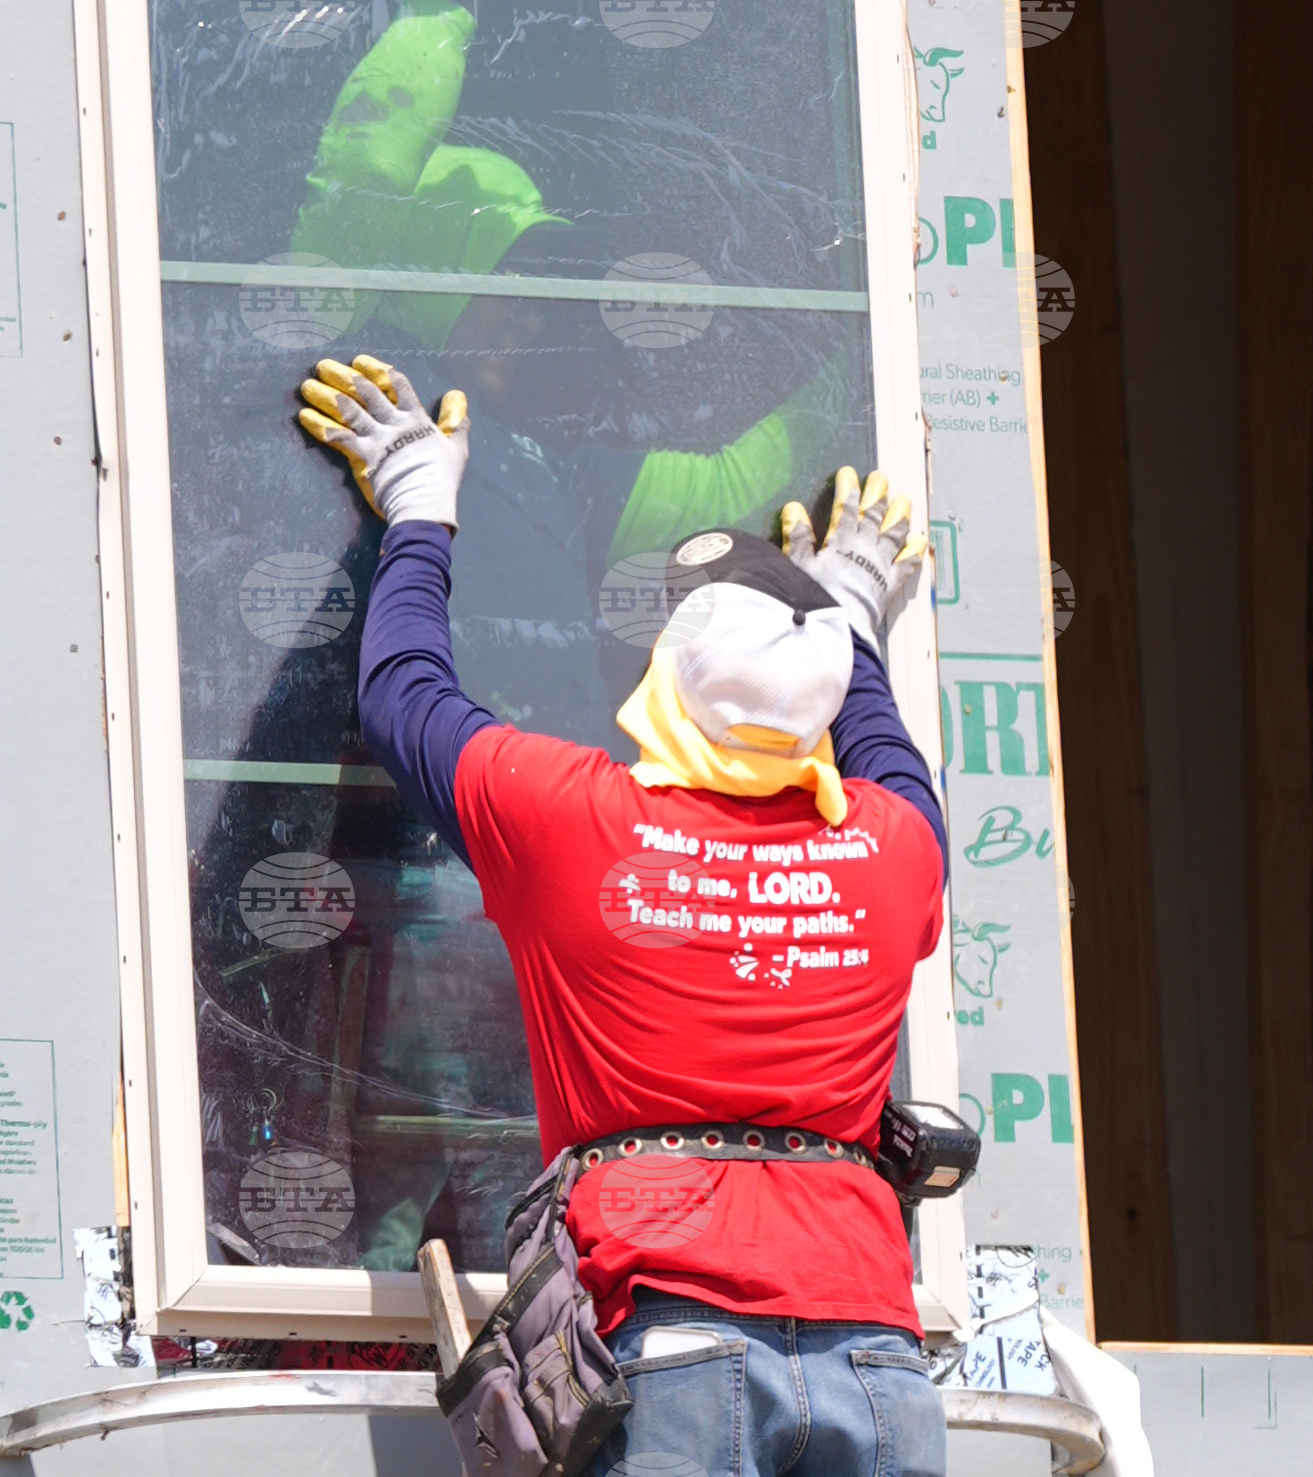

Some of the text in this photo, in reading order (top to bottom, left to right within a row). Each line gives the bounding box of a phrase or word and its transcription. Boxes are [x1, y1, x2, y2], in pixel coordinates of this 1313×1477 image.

[703, 839, 748, 863] your
[752, 844, 804, 867] ways
[806, 839, 868, 861] known
[668, 869, 840, 905] to me, LORD.
[627, 899, 693, 929] Teach
[698, 912, 732, 932] me
[738, 914, 787, 938] your
